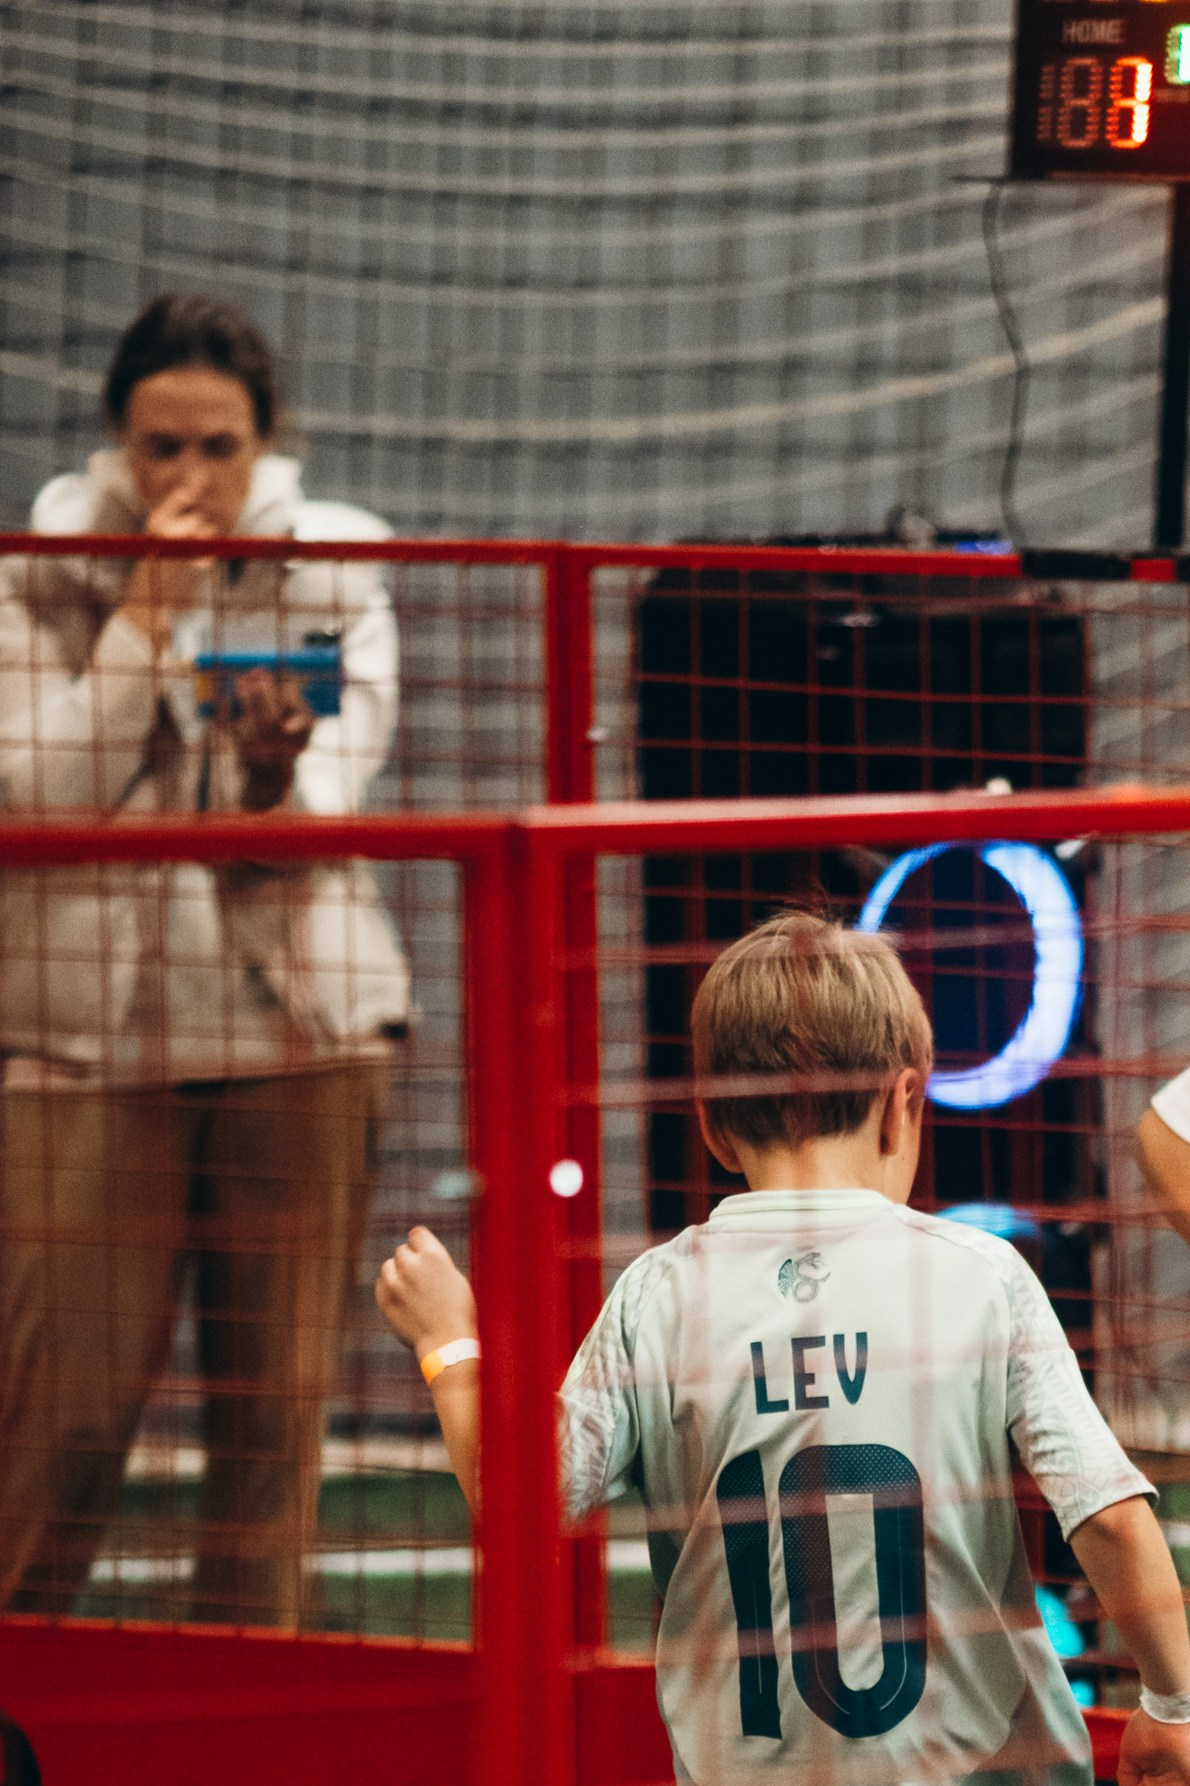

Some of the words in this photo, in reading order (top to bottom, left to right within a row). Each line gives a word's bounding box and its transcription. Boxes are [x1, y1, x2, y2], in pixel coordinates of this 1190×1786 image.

[1062, 19, 1125, 43] HOME
[750, 1331, 868, 1415] LEV
[716, 1443, 927, 1740] 10
